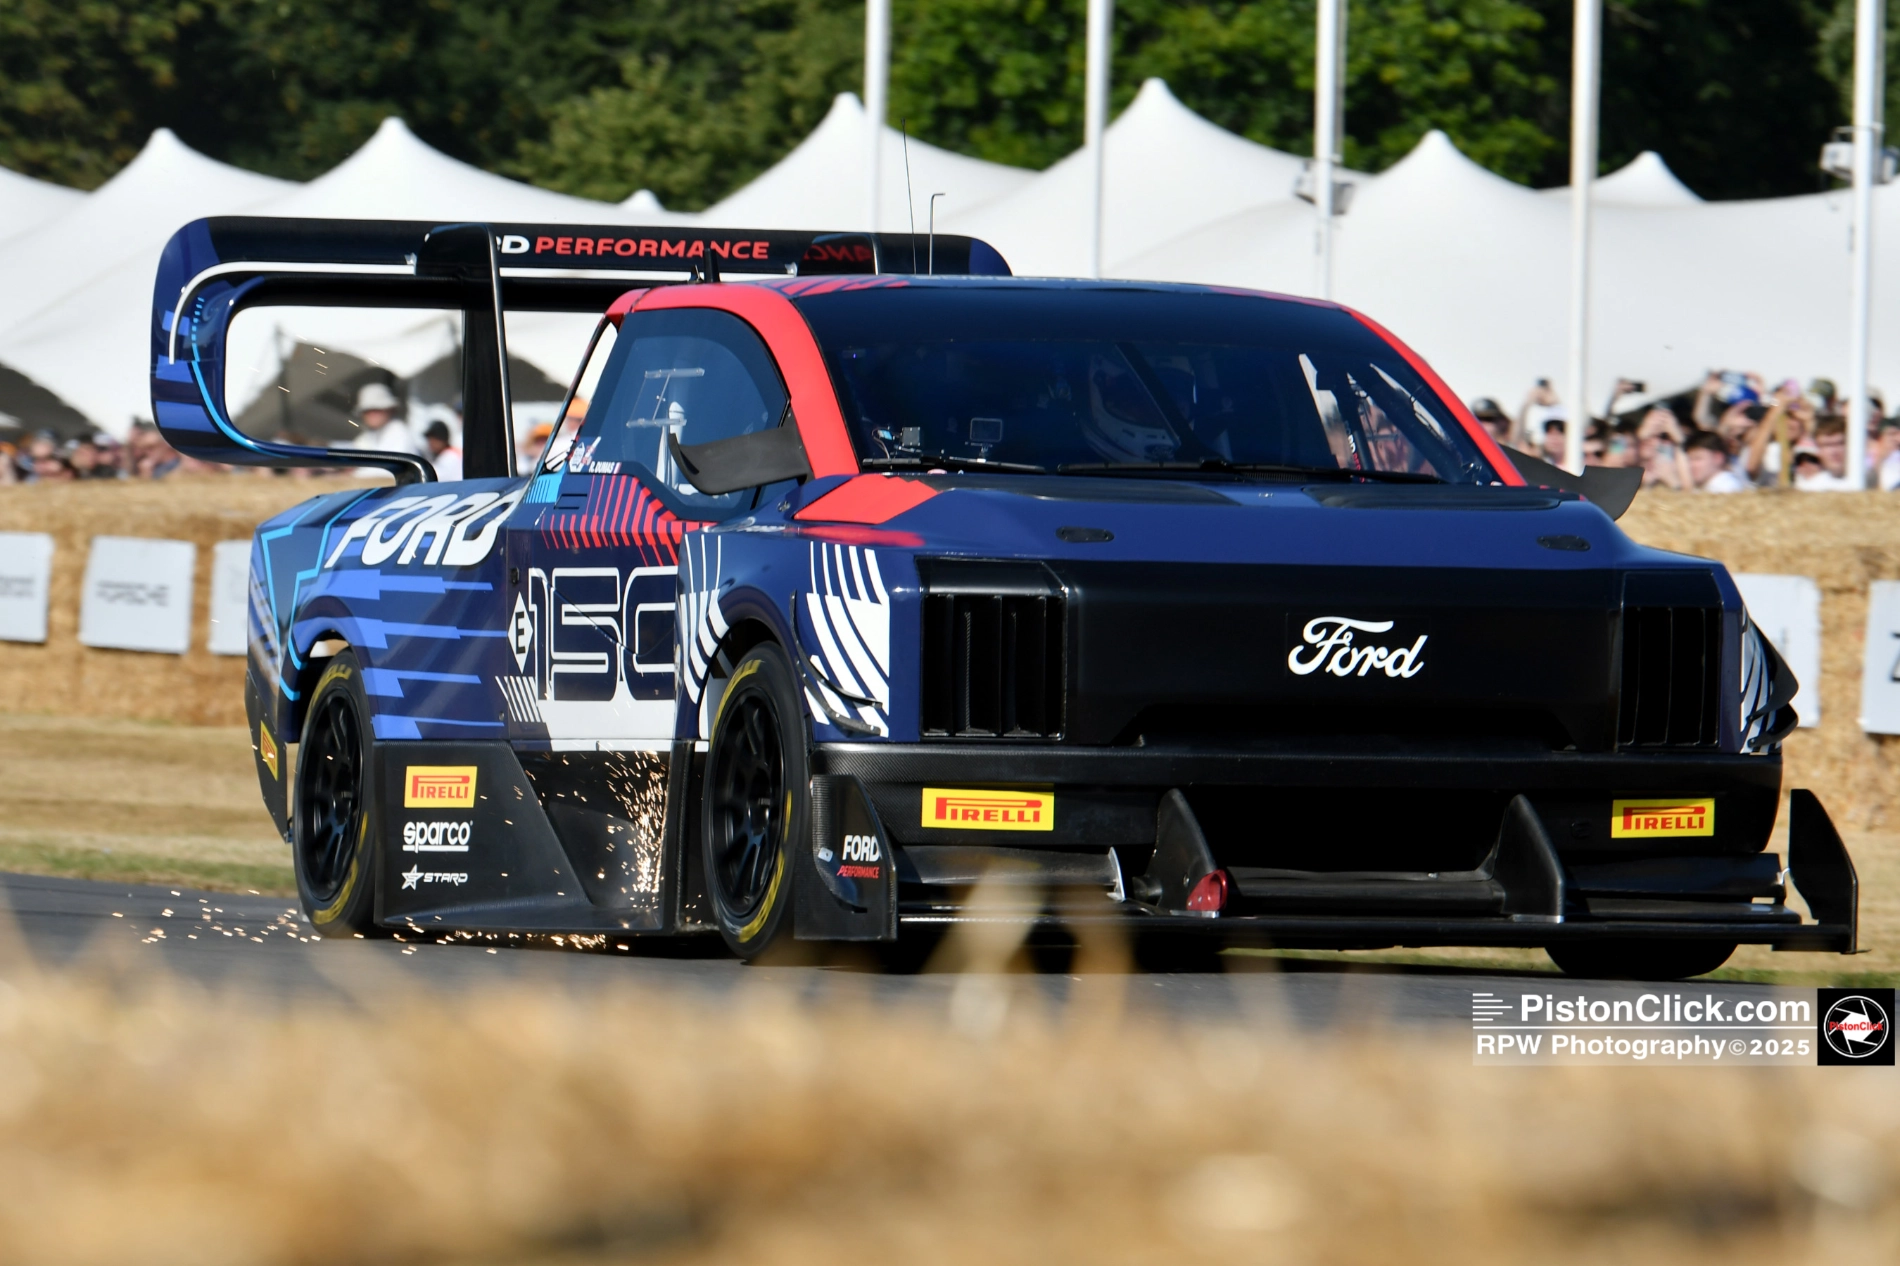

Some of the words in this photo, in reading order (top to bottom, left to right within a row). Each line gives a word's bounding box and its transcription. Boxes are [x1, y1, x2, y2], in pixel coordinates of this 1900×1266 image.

[535, 236, 770, 260] PERFORMANCE
[324, 489, 523, 569] FORD
[1288, 616, 1429, 678] Ford
[411, 775, 471, 799] PIRELLI
[935, 797, 1043, 823] PIRELLI
[1622, 806, 1706, 830] PIRELLI
[403, 821, 472, 853] sparco
[842, 834, 883, 862] FORD
[836, 864, 880, 879] PERFORMANCE
